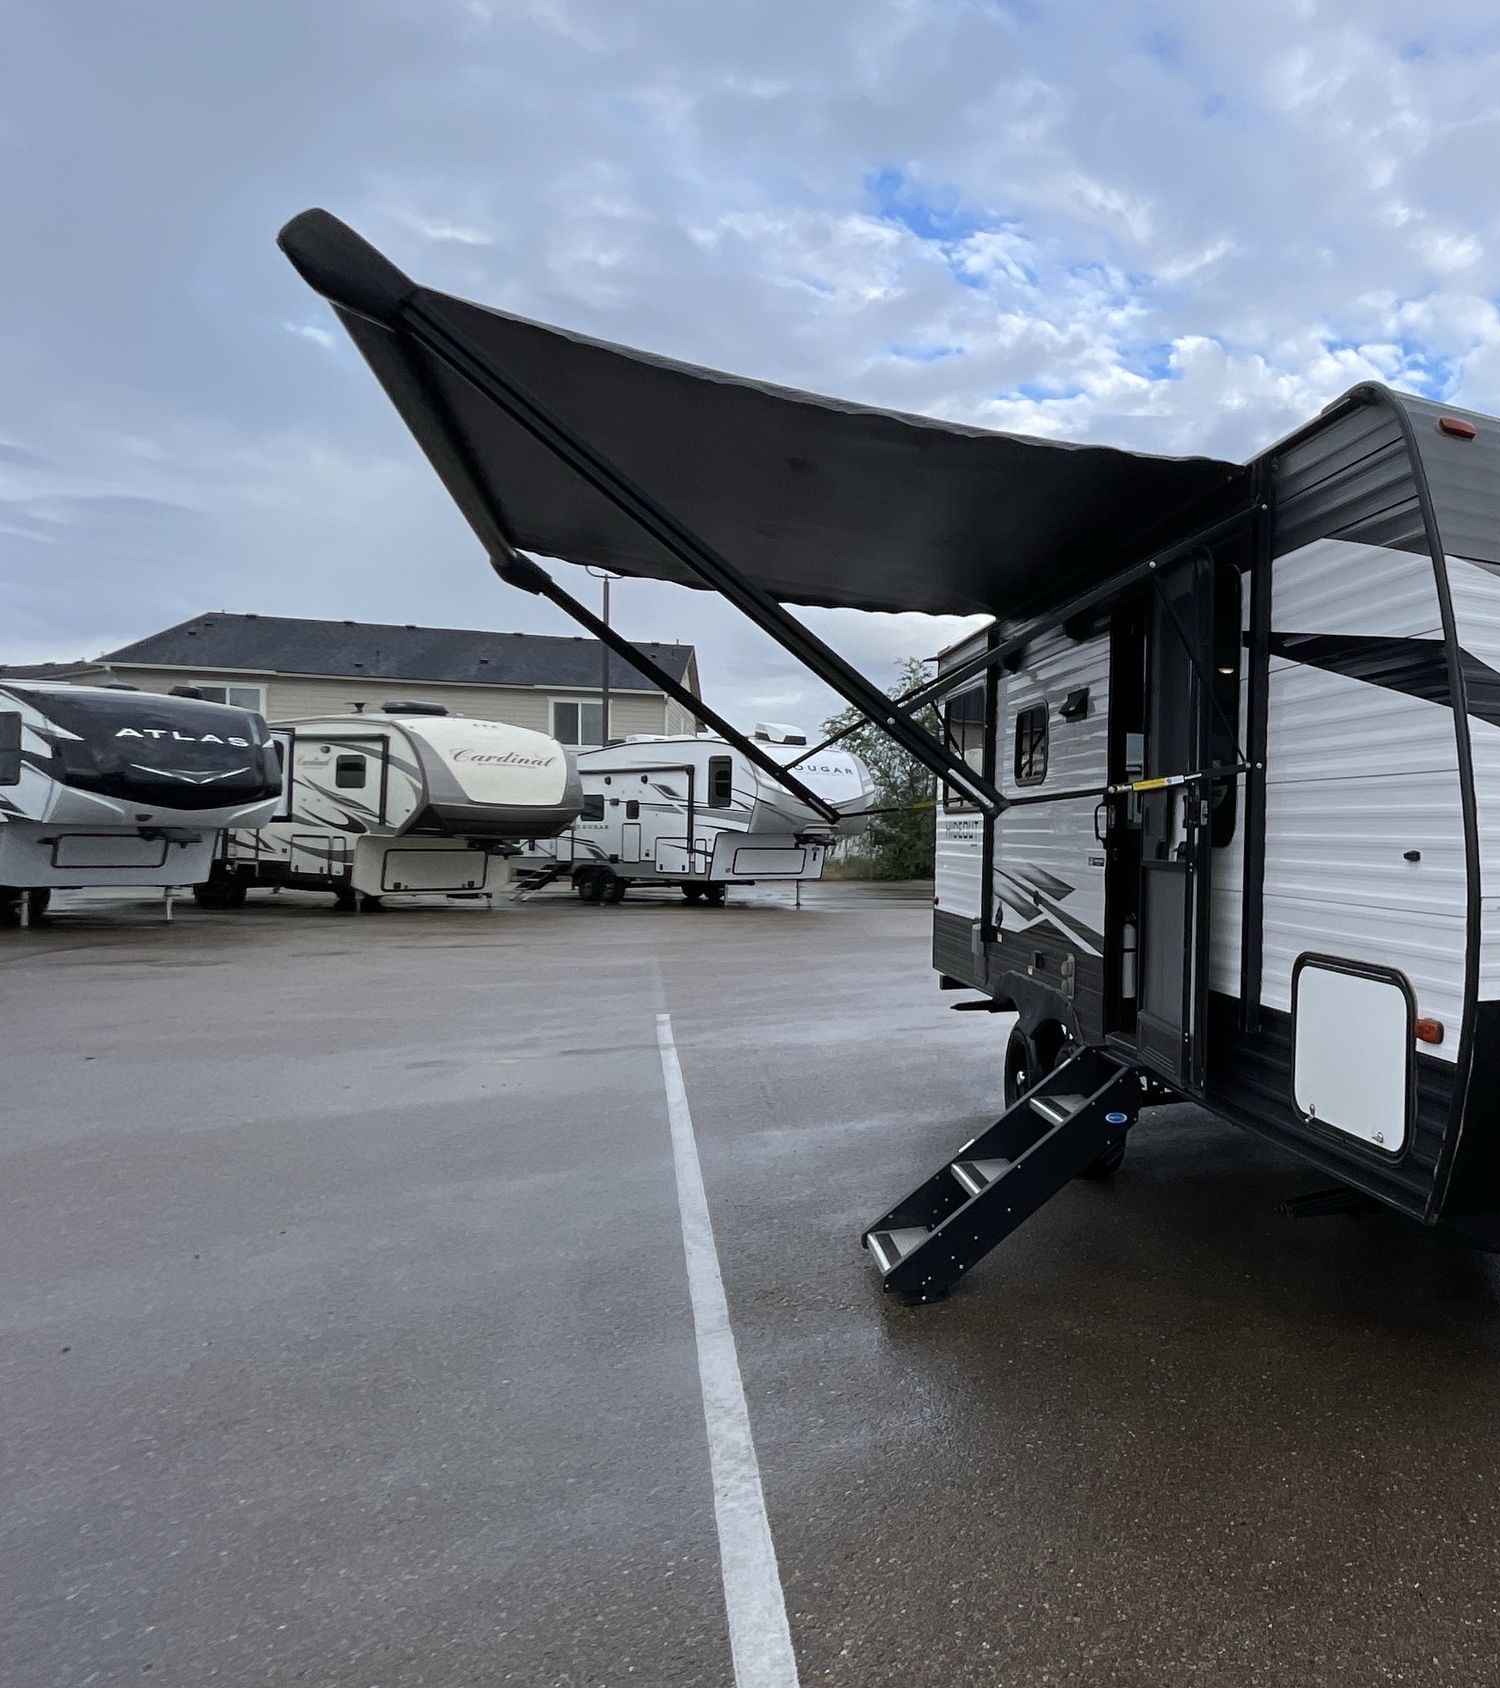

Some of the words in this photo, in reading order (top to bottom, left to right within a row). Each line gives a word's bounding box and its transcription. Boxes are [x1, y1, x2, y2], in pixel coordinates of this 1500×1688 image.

[115, 727, 249, 747] ATLAS
[450, 748, 556, 767] Cardinal
[782, 764, 854, 775] OUGAR
